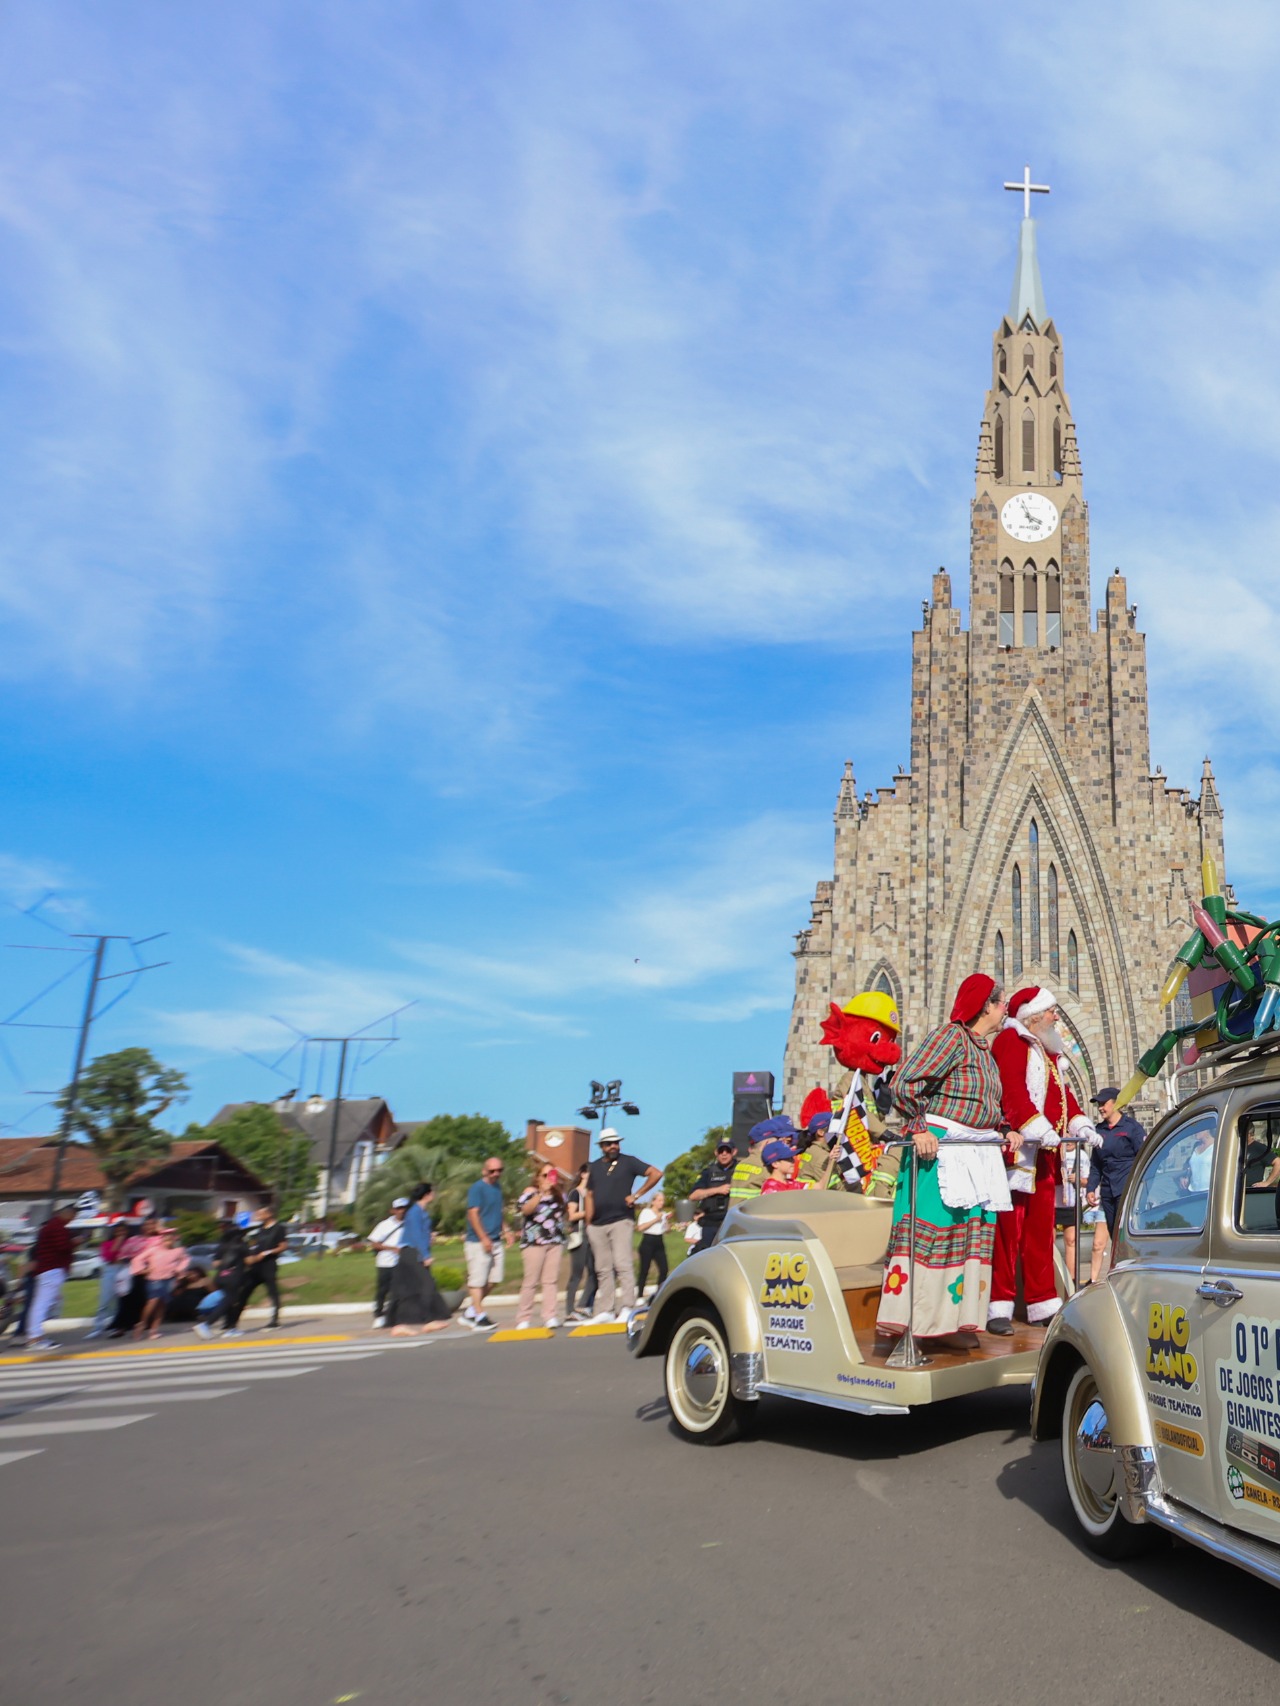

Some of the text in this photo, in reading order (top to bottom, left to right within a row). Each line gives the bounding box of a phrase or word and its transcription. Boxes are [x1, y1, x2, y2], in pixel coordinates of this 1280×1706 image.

[845, 1107, 874, 1172] MBEIROS
[764, 1253, 809, 1283] BIG
[760, 1283, 814, 1308] LAND
[770, 1317, 804, 1331] PARQUE
[1147, 1302, 1190, 1348] BIG
[765, 1335, 813, 1352] TEMÁTICO
[1235, 1321, 1247, 1364] O
[836, 1373, 896, 1390] @biglandoficial
[1145, 1348, 1199, 1389] LAND
[1219, 1367, 1234, 1394] DE
[1236, 1372, 1274, 1405] JOGOS
[1168, 1398, 1202, 1418] TEMÁTICO
[1245, 1485, 1268, 1505] CANELA
[1272, 1495, 1280, 1509] RS
